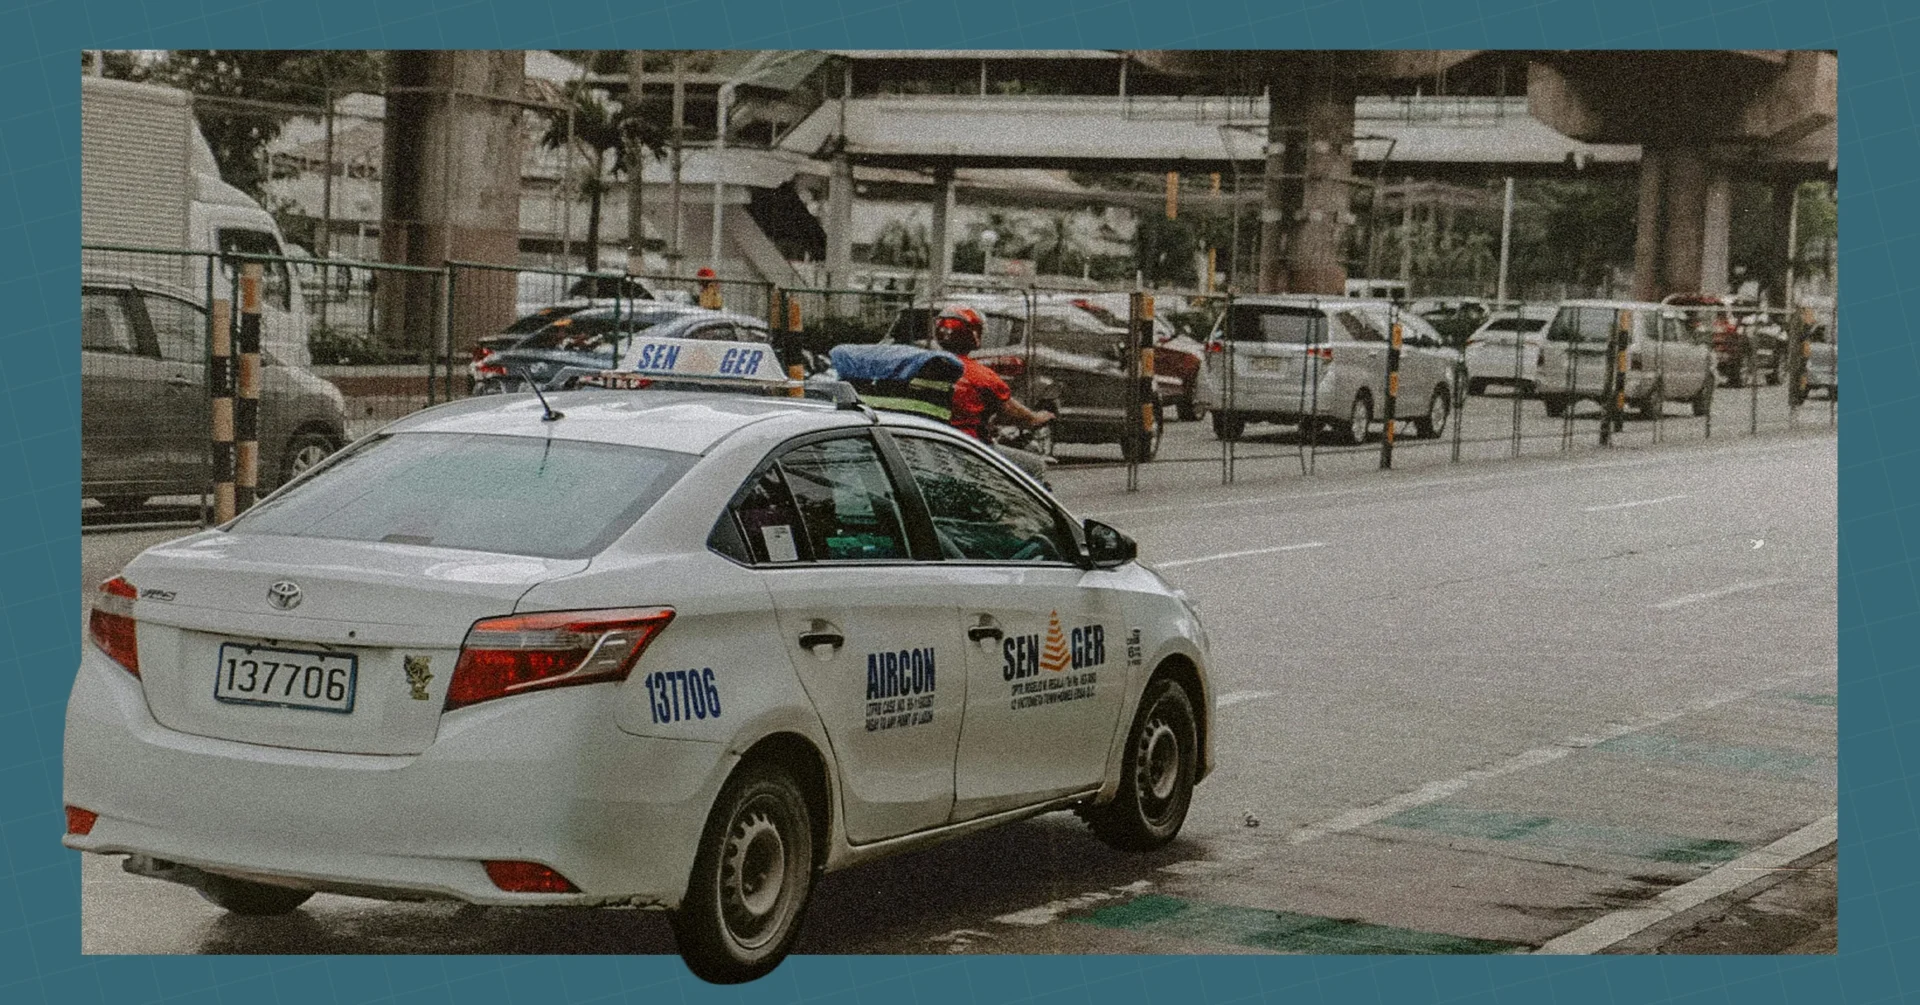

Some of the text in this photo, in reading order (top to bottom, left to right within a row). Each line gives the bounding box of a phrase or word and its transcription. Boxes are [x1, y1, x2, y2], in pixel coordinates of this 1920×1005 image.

[638, 343, 763, 375] SEN GER
[866, 647, 935, 700] AIRCON
[1003, 634, 1039, 681] SEN
[1071, 624, 1105, 670] GER
[225, 658, 346, 702] 137706
[645, 667, 721, 725] 137706
